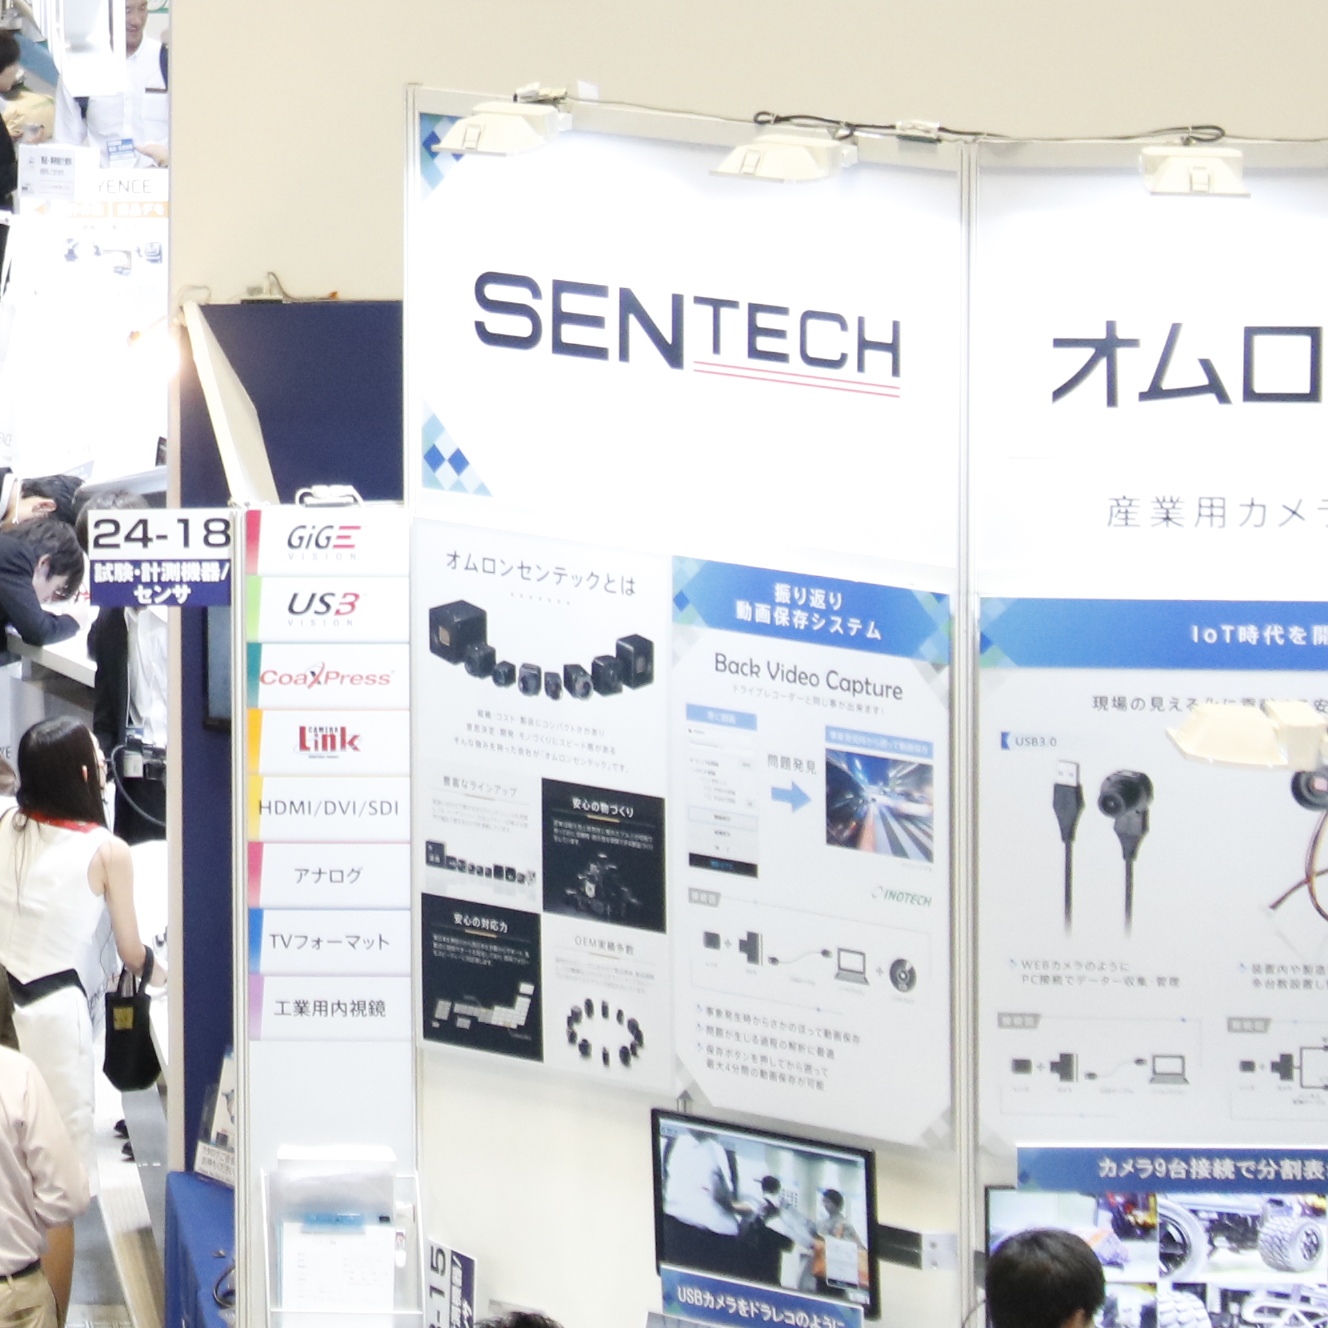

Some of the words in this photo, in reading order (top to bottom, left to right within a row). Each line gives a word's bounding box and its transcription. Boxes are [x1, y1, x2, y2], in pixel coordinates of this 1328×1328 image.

[474, 271, 901, 378] SENTECH
[1052, 320, 1323, 408] オムロ
[92, 518, 231, 550] 24-18
[288, 552, 357, 561] VISION
[446, 550, 637, 596] オムロンセンテックとは
[133, 584, 192, 605] センサ
[774, 582, 843, 611] 振り返り
[288, 618, 354, 627] VISION
[735, 599, 882, 640] 動画保存システム
[714, 652, 761, 679] Back
[767, 660, 820, 687] Video
[825, 669, 904, 701] Capture
[299, 726, 362, 753] Link
[308, 726, 340, 734] CAMERA
[1015, 736, 1057, 748] USB3.0
[258, 800, 399, 817] HDMI/DVI/SDI
[572, 796, 635, 818] 安心の物づくり
[293, 866, 364, 885] アナログ
[883, 888, 933, 908] INOTECH
[453, 912, 509, 934] 安心の対応力
[269, 933, 390, 950] TVフォーマット
[273, 999, 386, 1018] 工業用内視鏡
[1098, 1156, 1328, 1180] カメラ9台接続で分割表
[429, 1245, 447, 1328] -15
